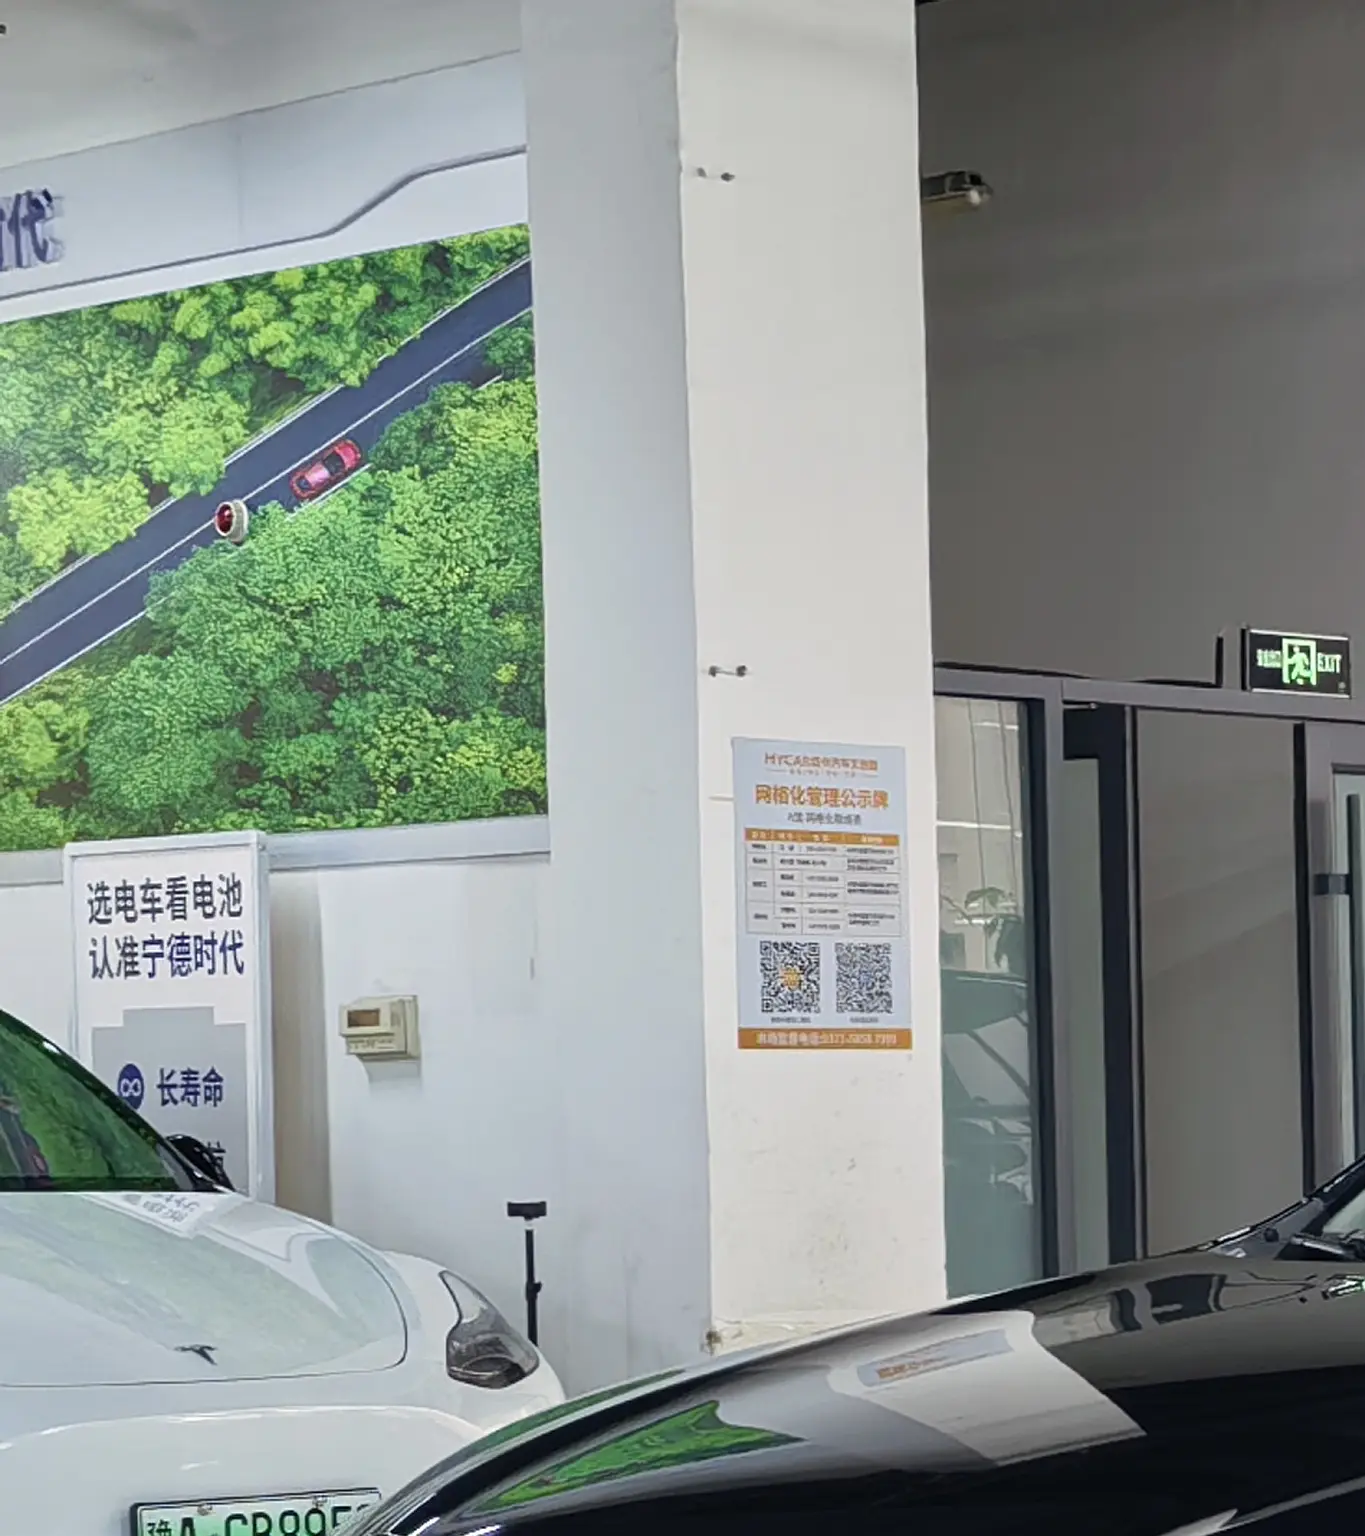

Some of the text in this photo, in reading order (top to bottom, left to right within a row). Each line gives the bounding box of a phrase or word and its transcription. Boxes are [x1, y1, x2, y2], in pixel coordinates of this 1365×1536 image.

[87, 872, 243, 925] 选电车看电池
[89, 930, 245, 980] 认准宁德时代
[156, 1066, 225, 1108] 长寿命
